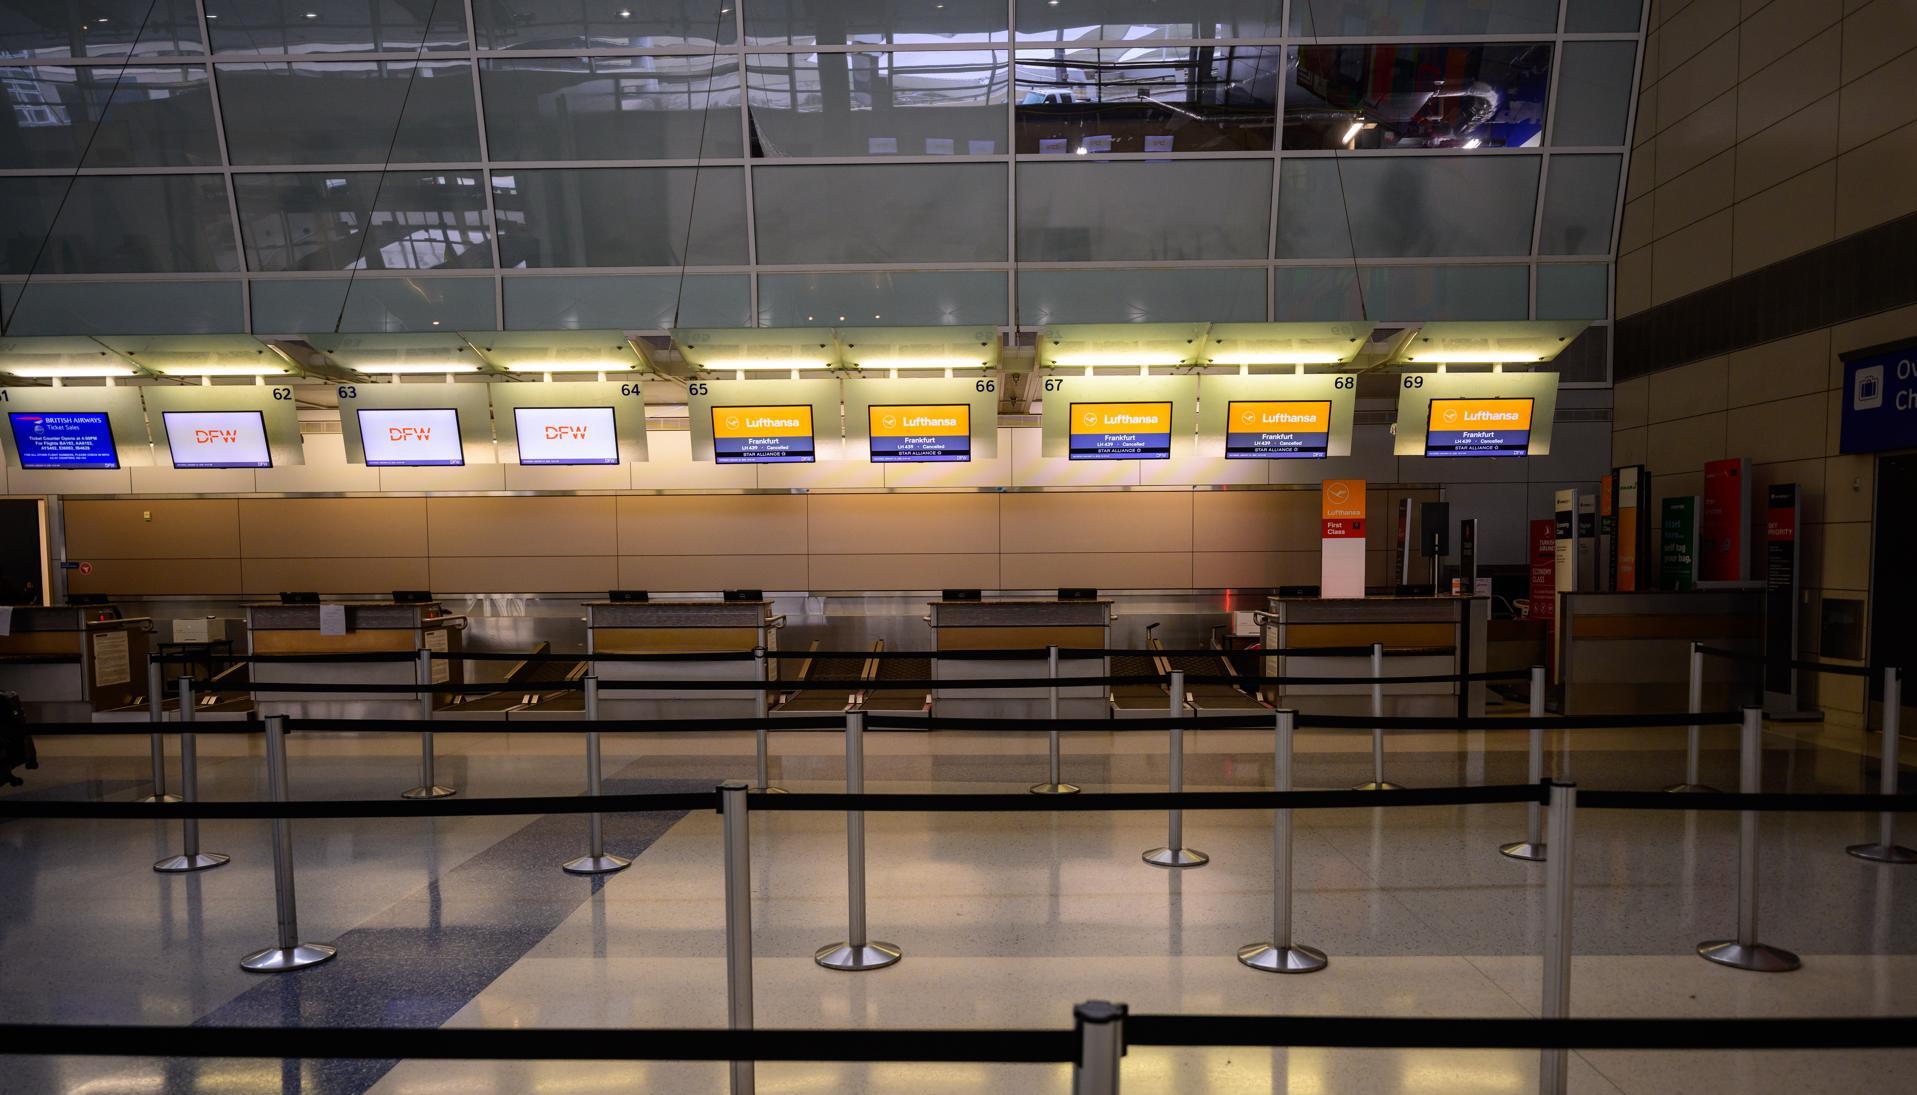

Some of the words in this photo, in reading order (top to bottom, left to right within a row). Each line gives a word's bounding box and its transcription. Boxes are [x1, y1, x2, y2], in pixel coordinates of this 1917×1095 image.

[976, 380, 995, 392] 66
[1045, 379, 1063, 391] 67
[1334, 377, 1354, 389] 68
[1404, 376, 1423, 388] 69
[0, 390, 8, 402] 1
[273, 388, 292, 400] 62
[338, 386, 356, 398] 63
[622, 384, 640, 396] 64
[689, 384, 708, 396] 65
[1104, 414, 1158, 424] Lufthansa
[1262, 413, 1316, 422] Lufthansa
[1464, 410, 1518, 420] Lufthansa
[745, 418, 799, 428] Lufthansa
[903, 416, 956, 427] Lufthansa
[196, 430, 236, 444] DFW
[389, 427, 430, 440] DFW
[545, 426, 586, 440] DFW
